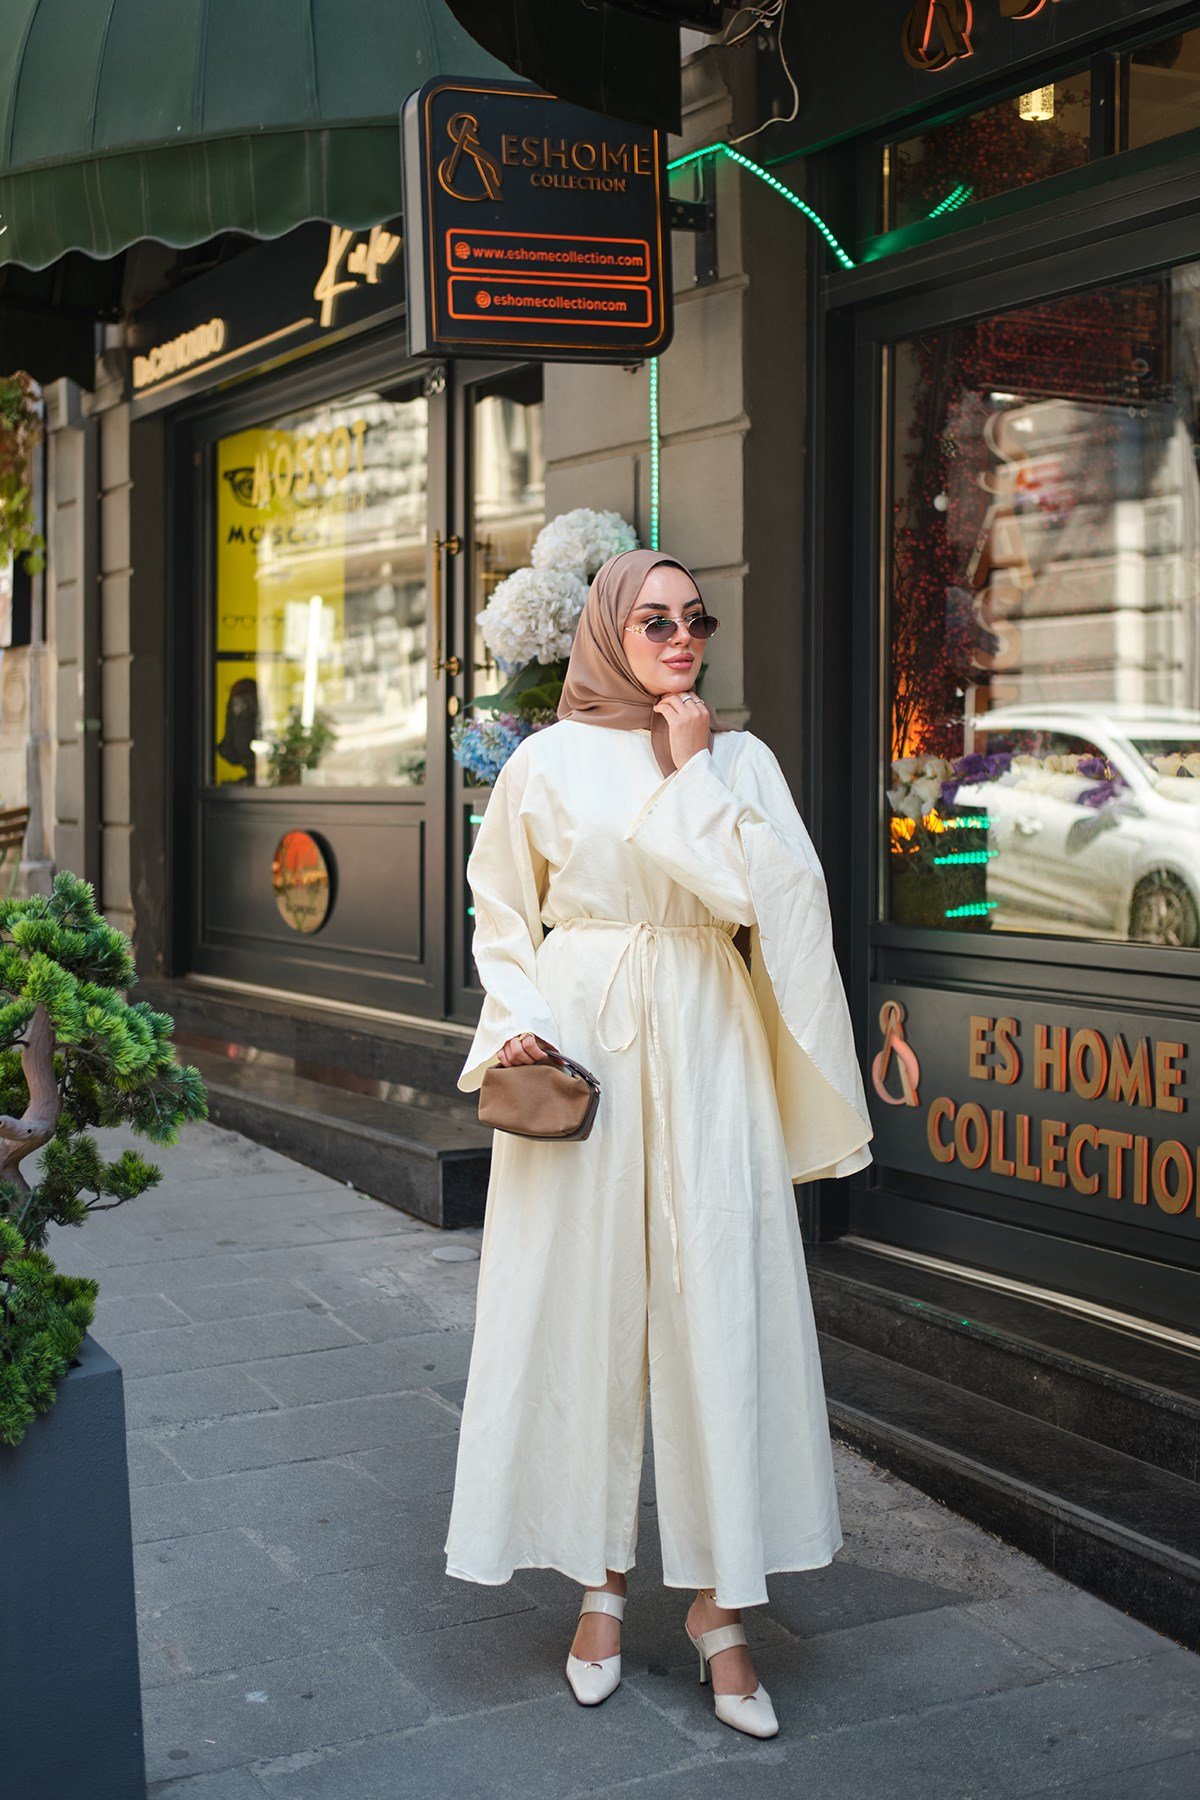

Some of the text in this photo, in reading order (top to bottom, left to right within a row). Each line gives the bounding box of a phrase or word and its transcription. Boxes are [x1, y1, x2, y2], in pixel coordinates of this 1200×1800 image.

[530, 172, 626, 192] COLLECTION
[473, 246, 644, 267] www.eshomecollection.com
[493, 293, 627, 312] eshomecollectioncom
[252, 419, 367, 507] MOSCOT
[969, 1015, 1183, 1113] ES HOME
[927, 1096, 1200, 1218] COLLECTIO
